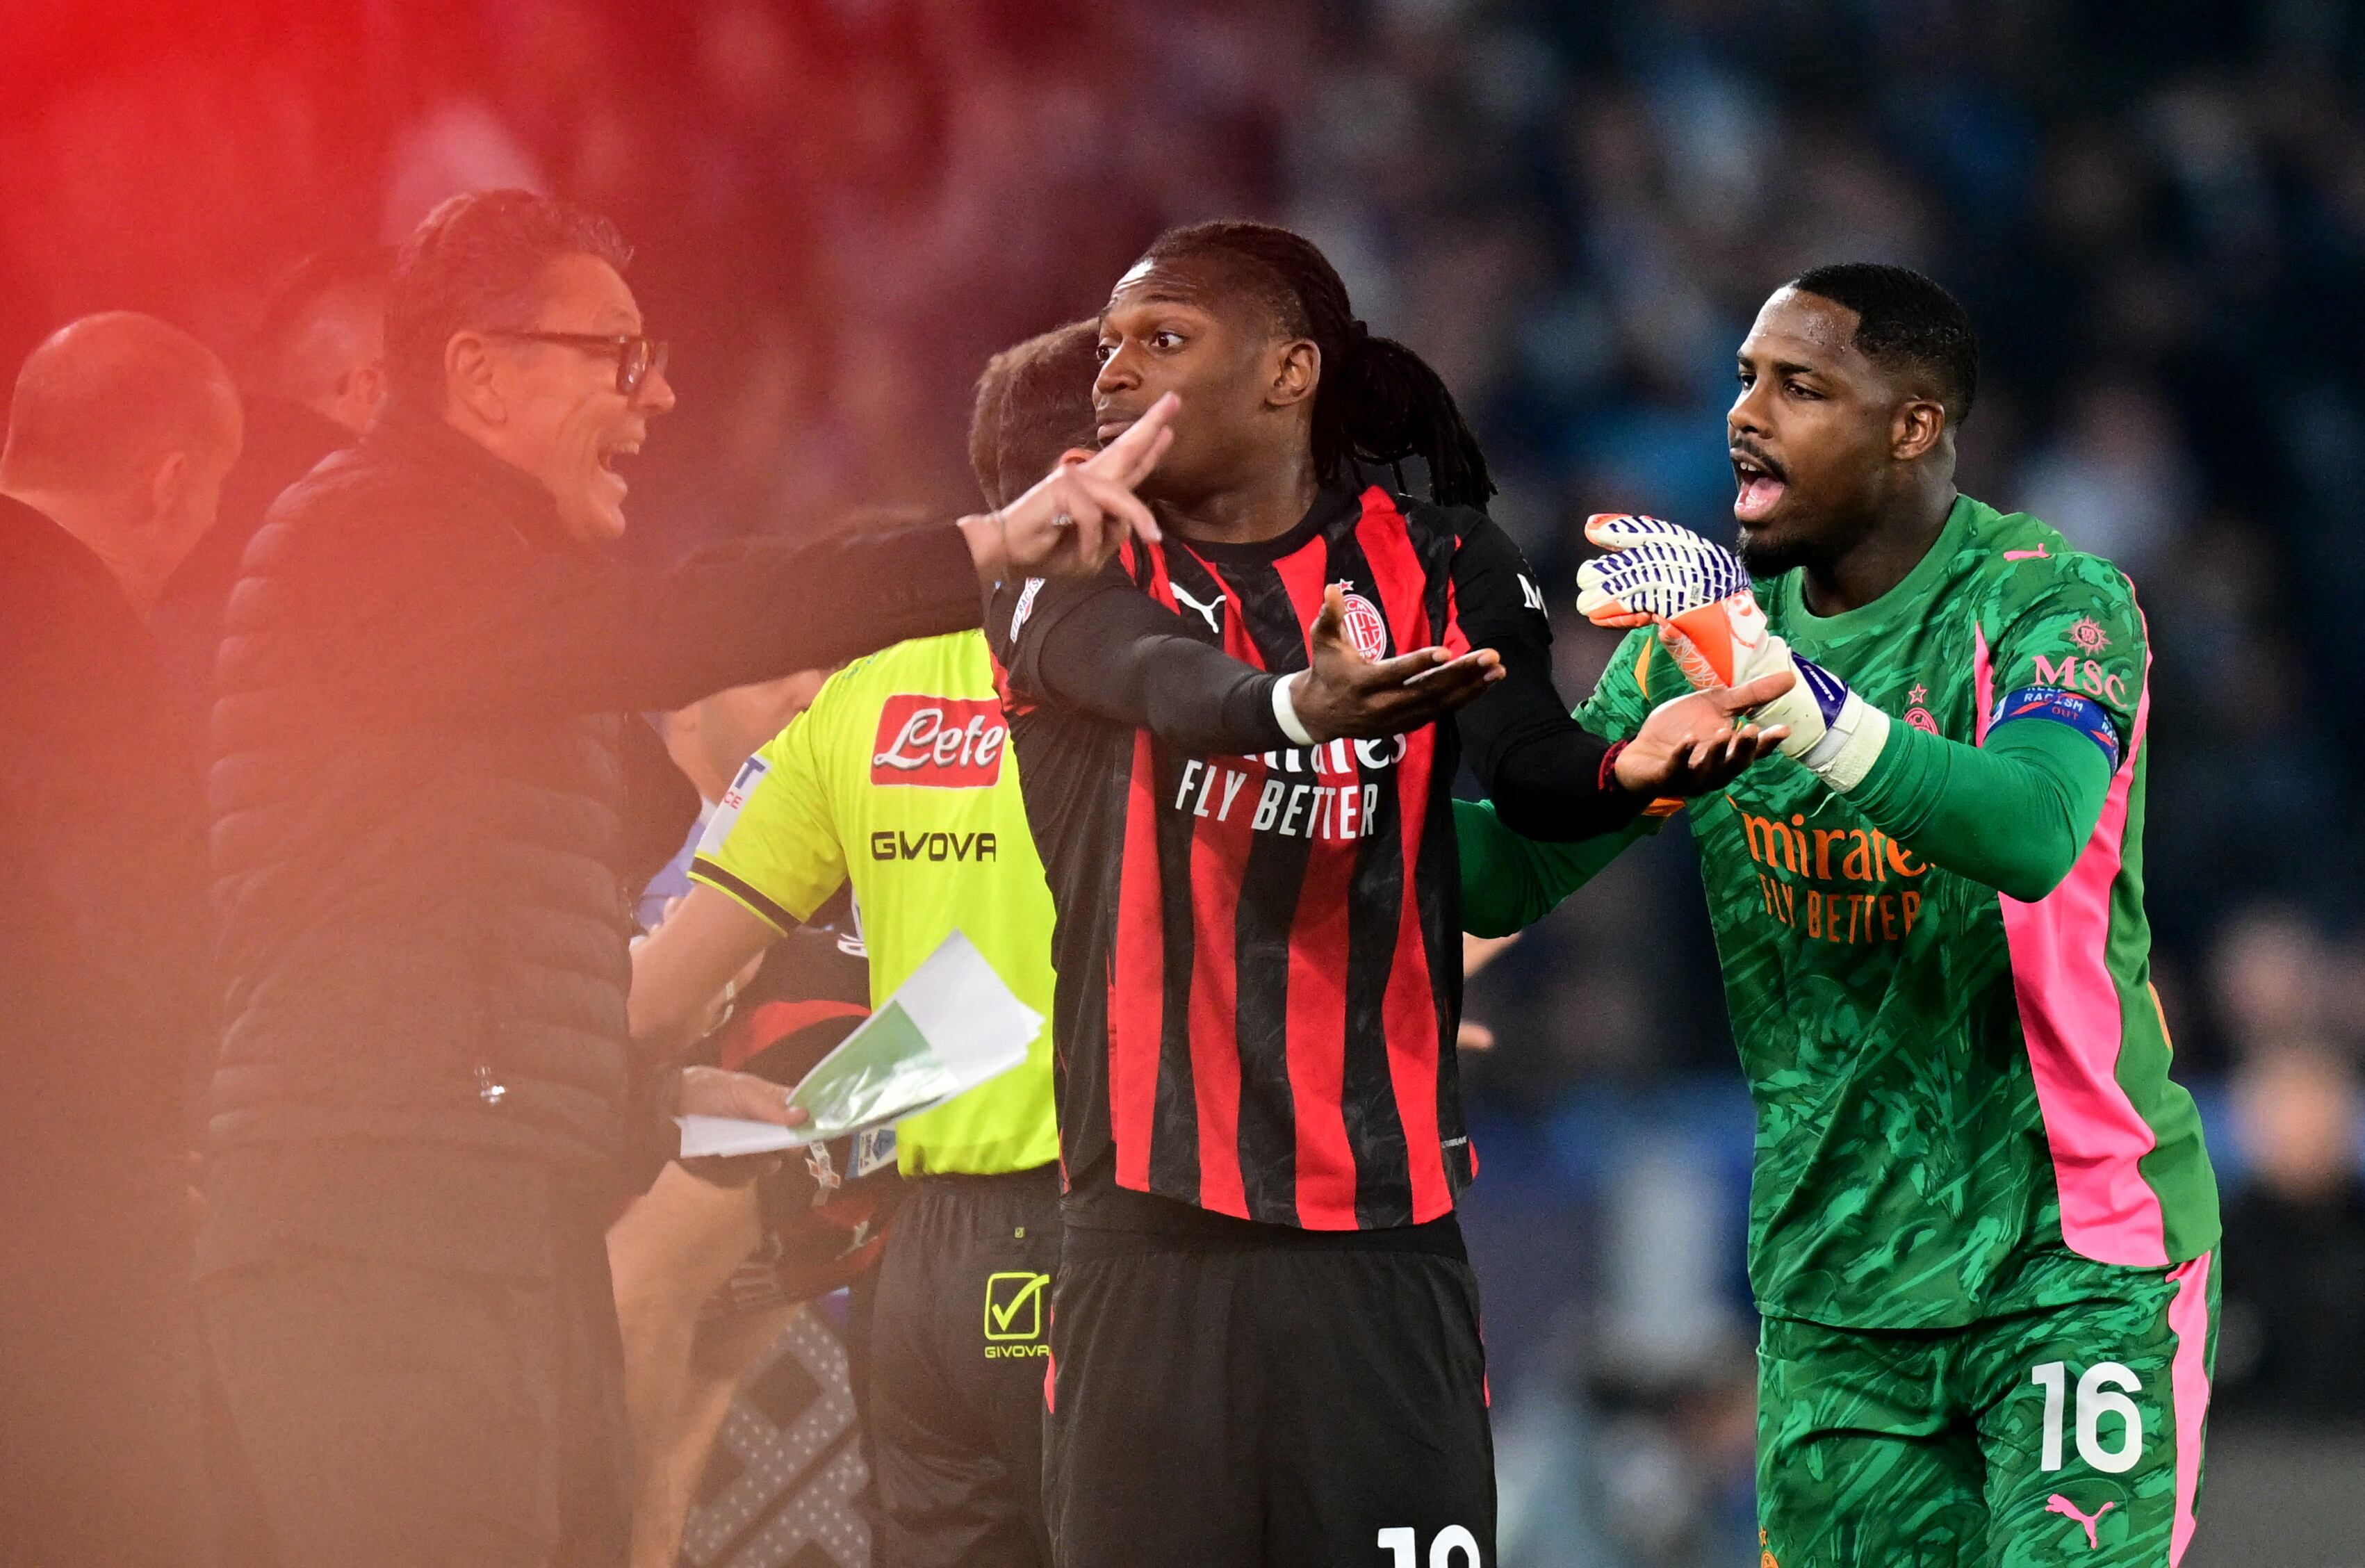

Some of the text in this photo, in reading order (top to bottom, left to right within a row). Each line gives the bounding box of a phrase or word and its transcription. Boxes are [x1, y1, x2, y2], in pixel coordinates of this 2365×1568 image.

[2031, 655, 2127, 708] MSC
[874, 708, 1004, 770] Lete
[1175, 759, 1378, 840] FLY BETTER
[1726, 794, 1937, 882] mirate
[984, 1344, 1050, 1359] GIVOVA
[2031, 1361, 2143, 1473] 16
